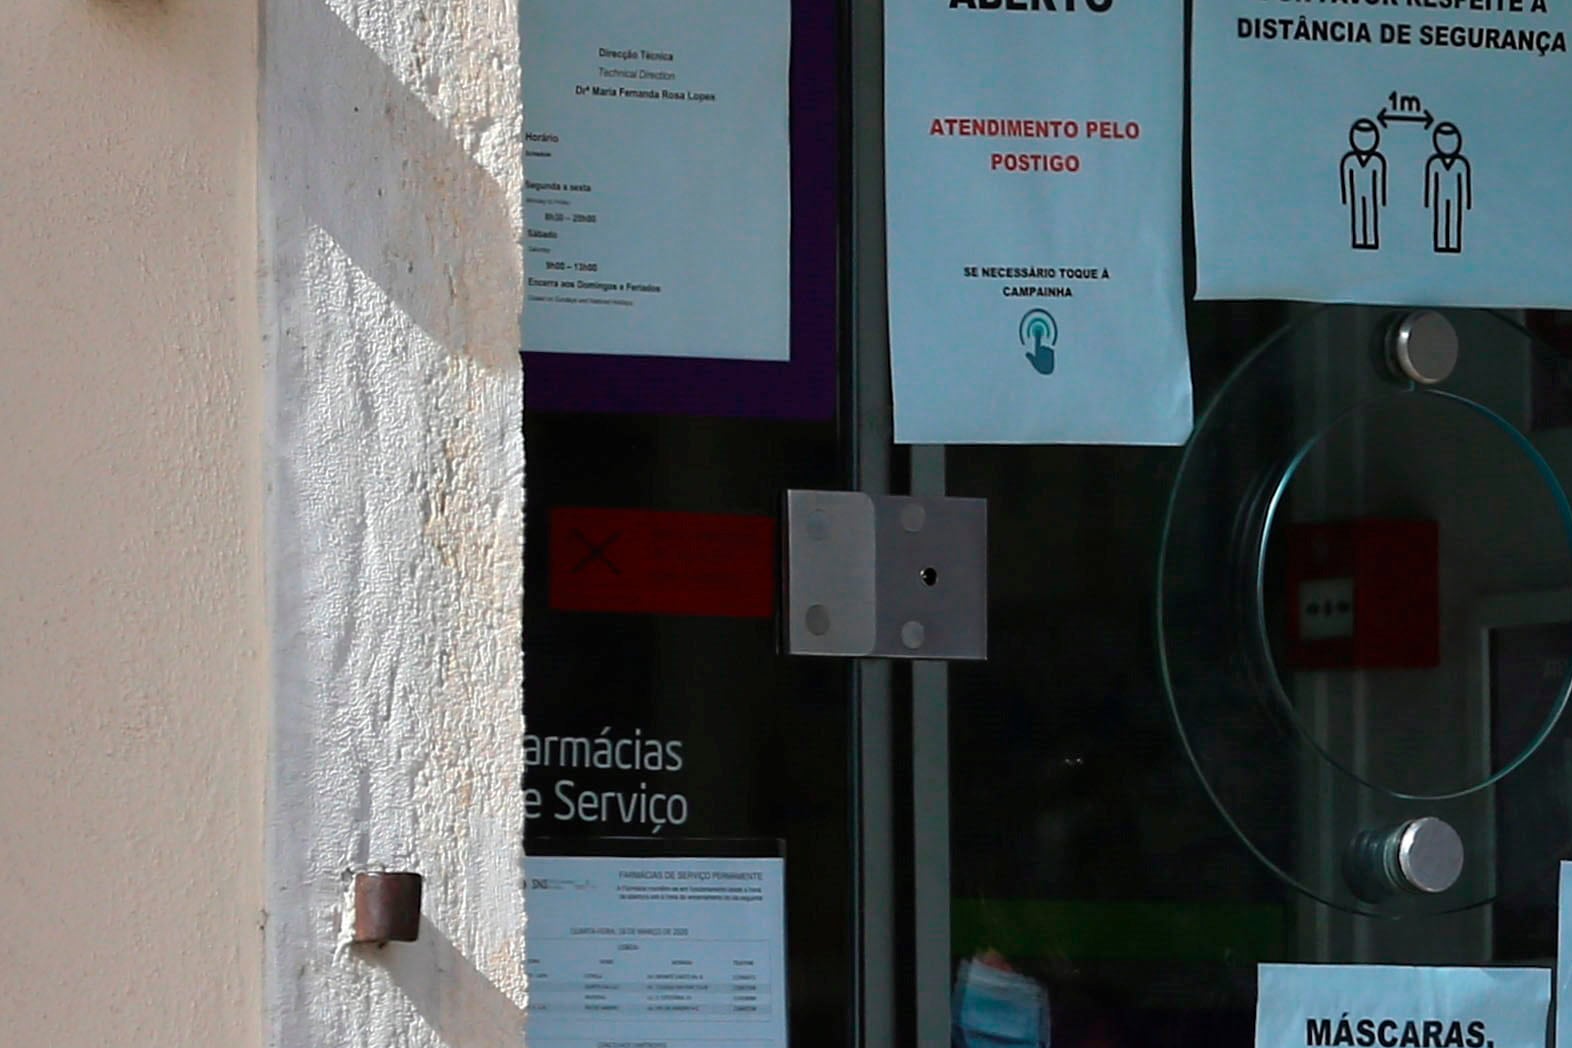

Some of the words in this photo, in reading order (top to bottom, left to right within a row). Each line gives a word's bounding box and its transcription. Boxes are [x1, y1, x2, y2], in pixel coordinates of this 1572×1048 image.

[1238, 16, 1371, 43] DISTÂNCIA
[1380, 24, 1411, 44] DE
[1420, 25, 1566, 56] SEGURANÇA
[592, 87, 616, 96] Maria
[662, 90, 686, 100] Rosa
[1388, 91, 1420, 112] 1m
[525, 132, 558, 142] Horário
[931, 117, 1078, 138] ATENDIMENTO
[1087, 122, 1139, 139] PELO
[992, 154, 1079, 172] POSTIGO
[964, 267, 978, 277] SE
[982, 266, 1056, 278] NECESSÁRIO
[1059, 269, 1098, 279] TOQUE
[1003, 287, 1072, 296] CAMPAINHA
[524, 726, 683, 771] armácias
[524, 787, 541, 818] e
[554, 780, 687, 834] Serviço
